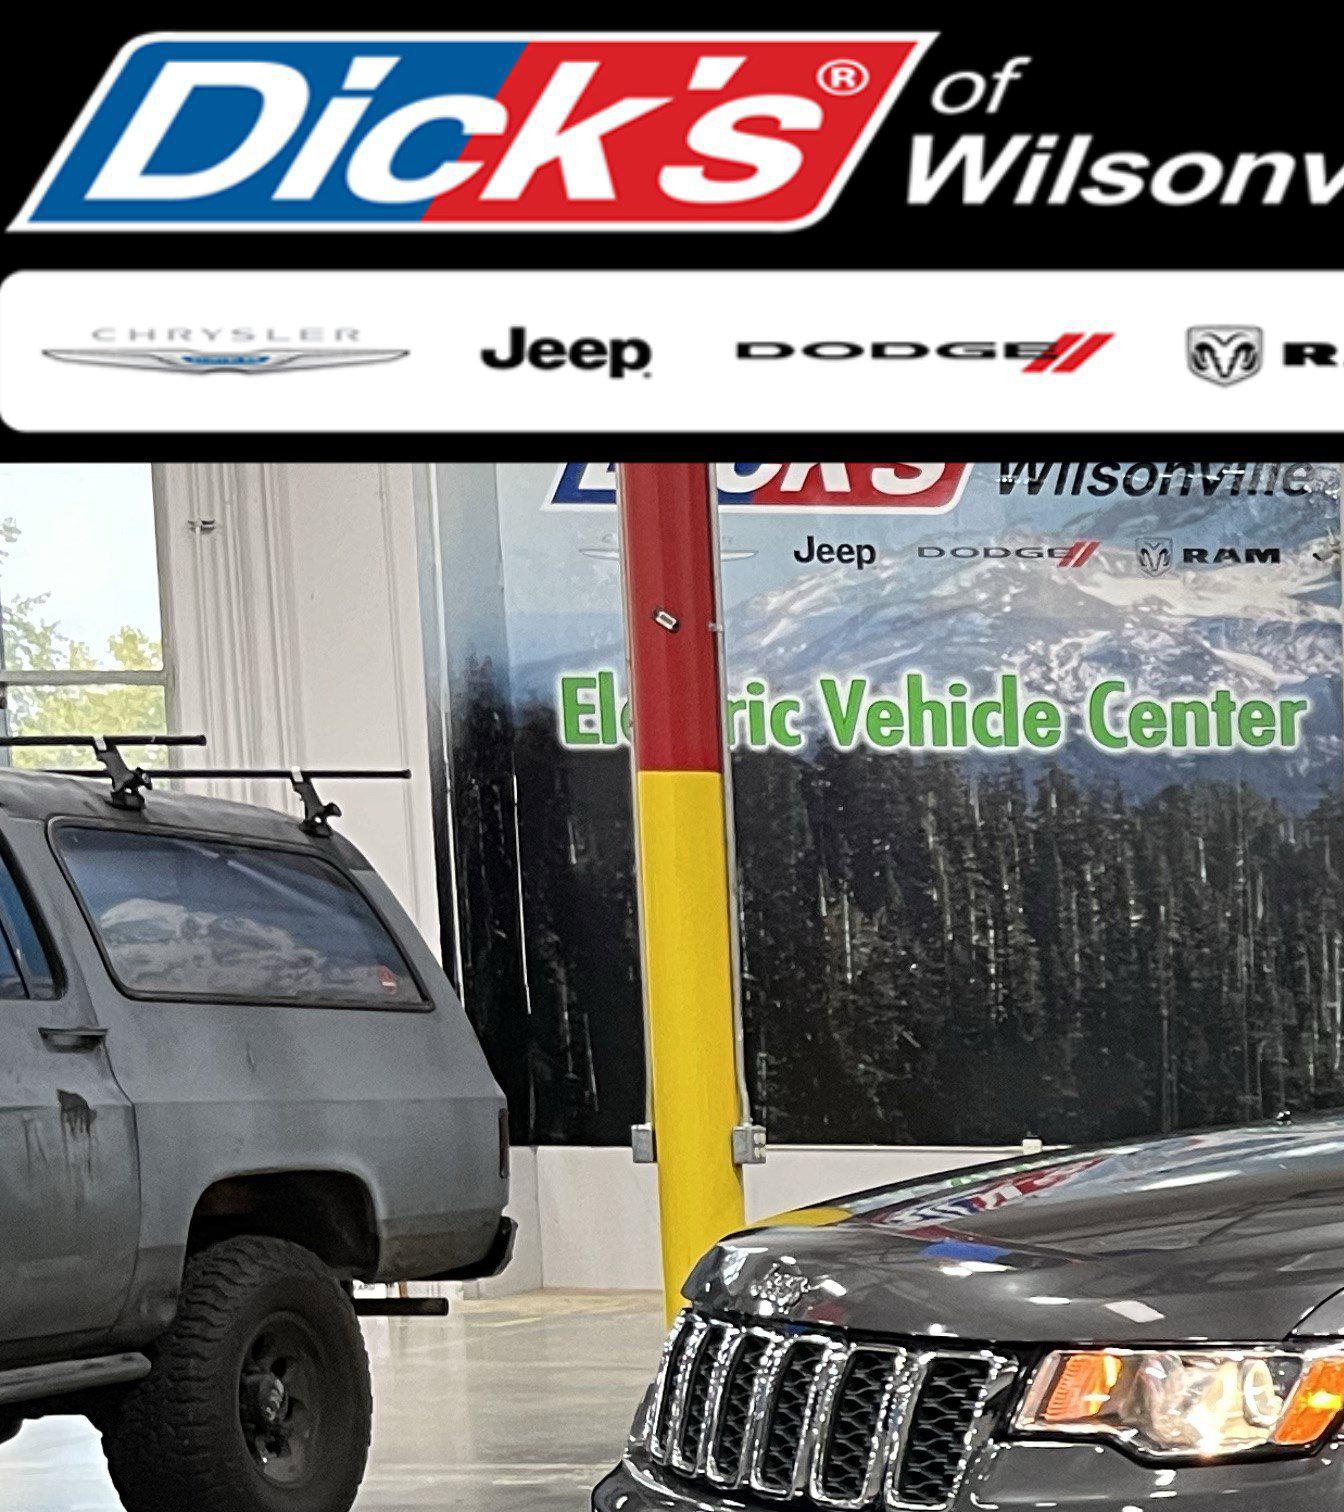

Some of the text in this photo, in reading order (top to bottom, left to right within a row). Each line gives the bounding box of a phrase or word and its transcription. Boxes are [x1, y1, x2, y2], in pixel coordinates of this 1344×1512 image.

[794, 535, 877, 571] Jeep
[917, 546, 1066, 559] DODGE
[1182, 547, 1281, 564] RAM
[562, 671, 1308, 746] Elric Vehicle Center
